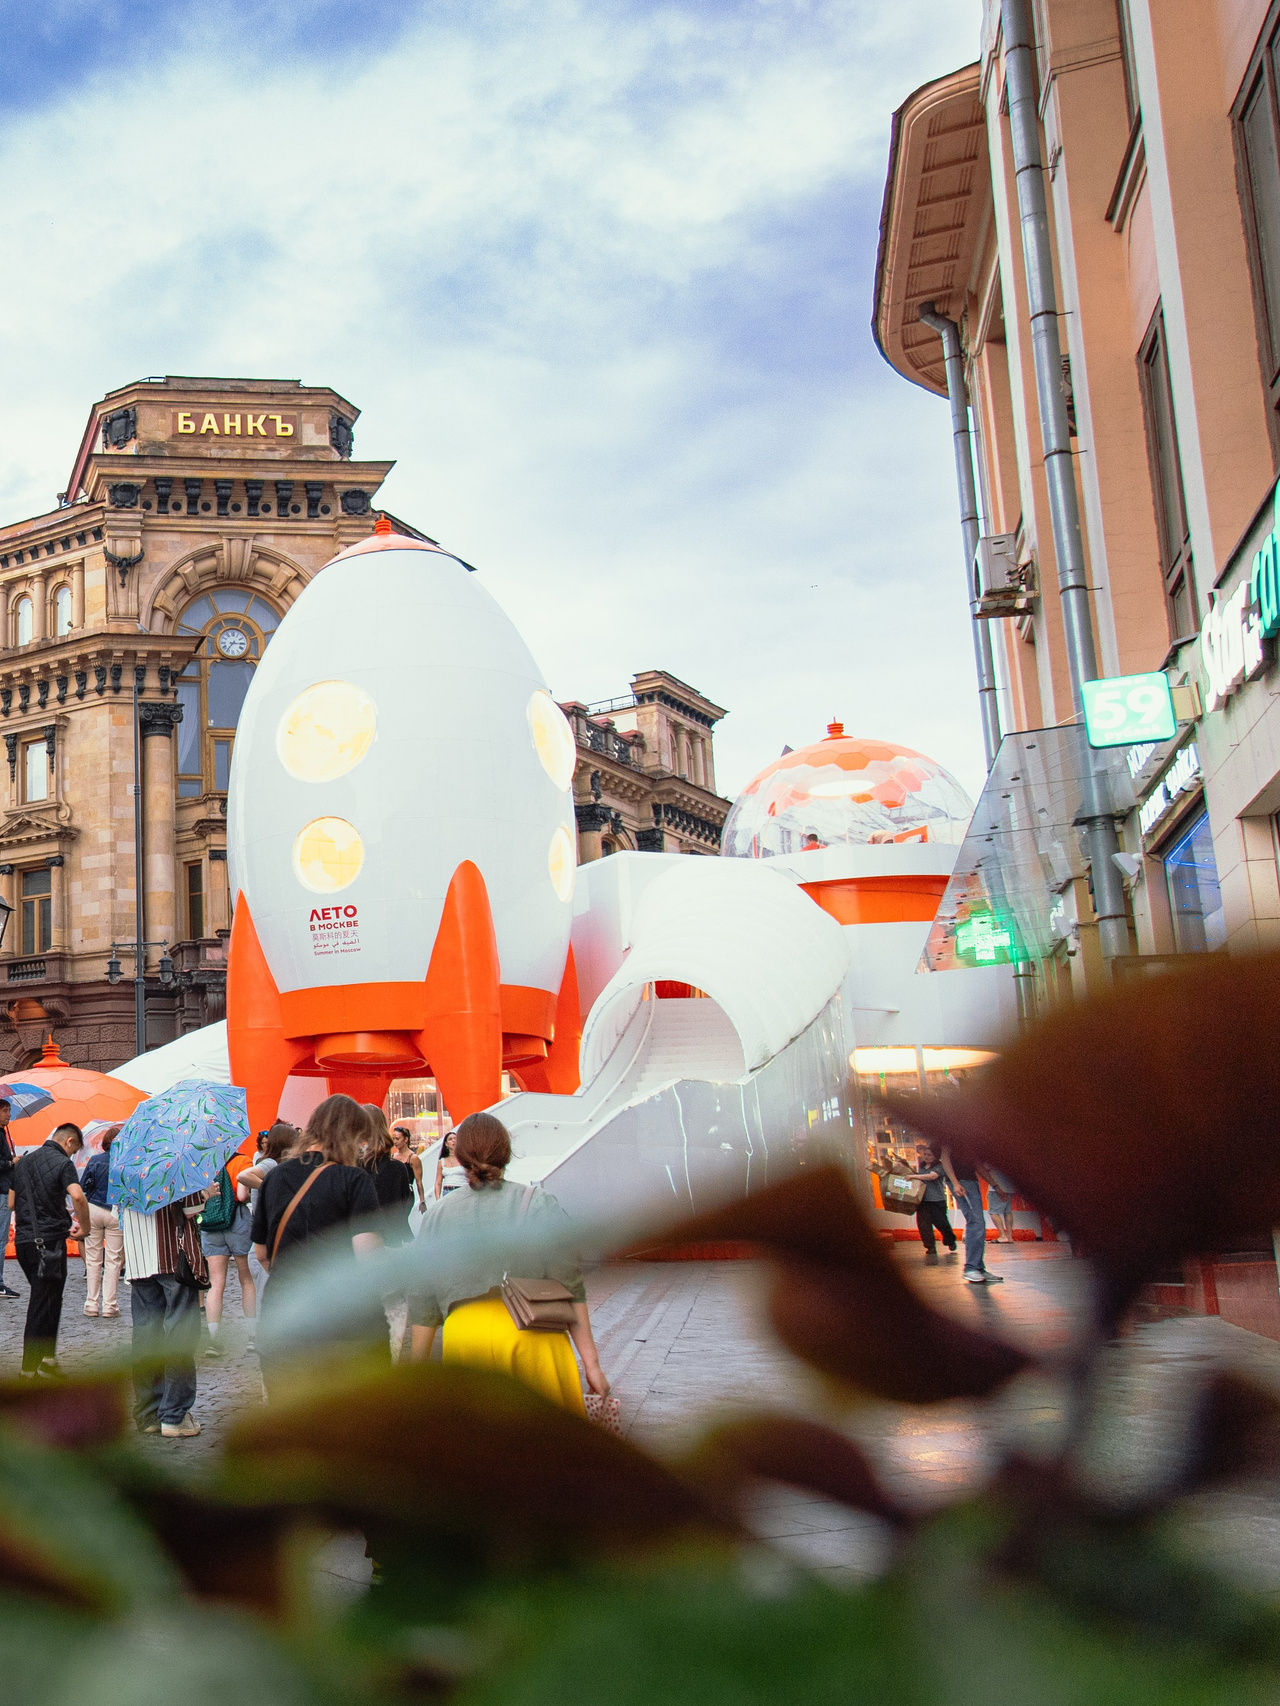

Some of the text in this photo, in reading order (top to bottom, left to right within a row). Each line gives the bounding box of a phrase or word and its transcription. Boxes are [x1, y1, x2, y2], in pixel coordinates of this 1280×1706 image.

[177, 412, 294, 437] БАНКЪ
[1092, 685, 1166, 730] 59
[309, 904, 357, 922] ЛЕТО
[318, 920, 359, 931] МОСКВЕ
